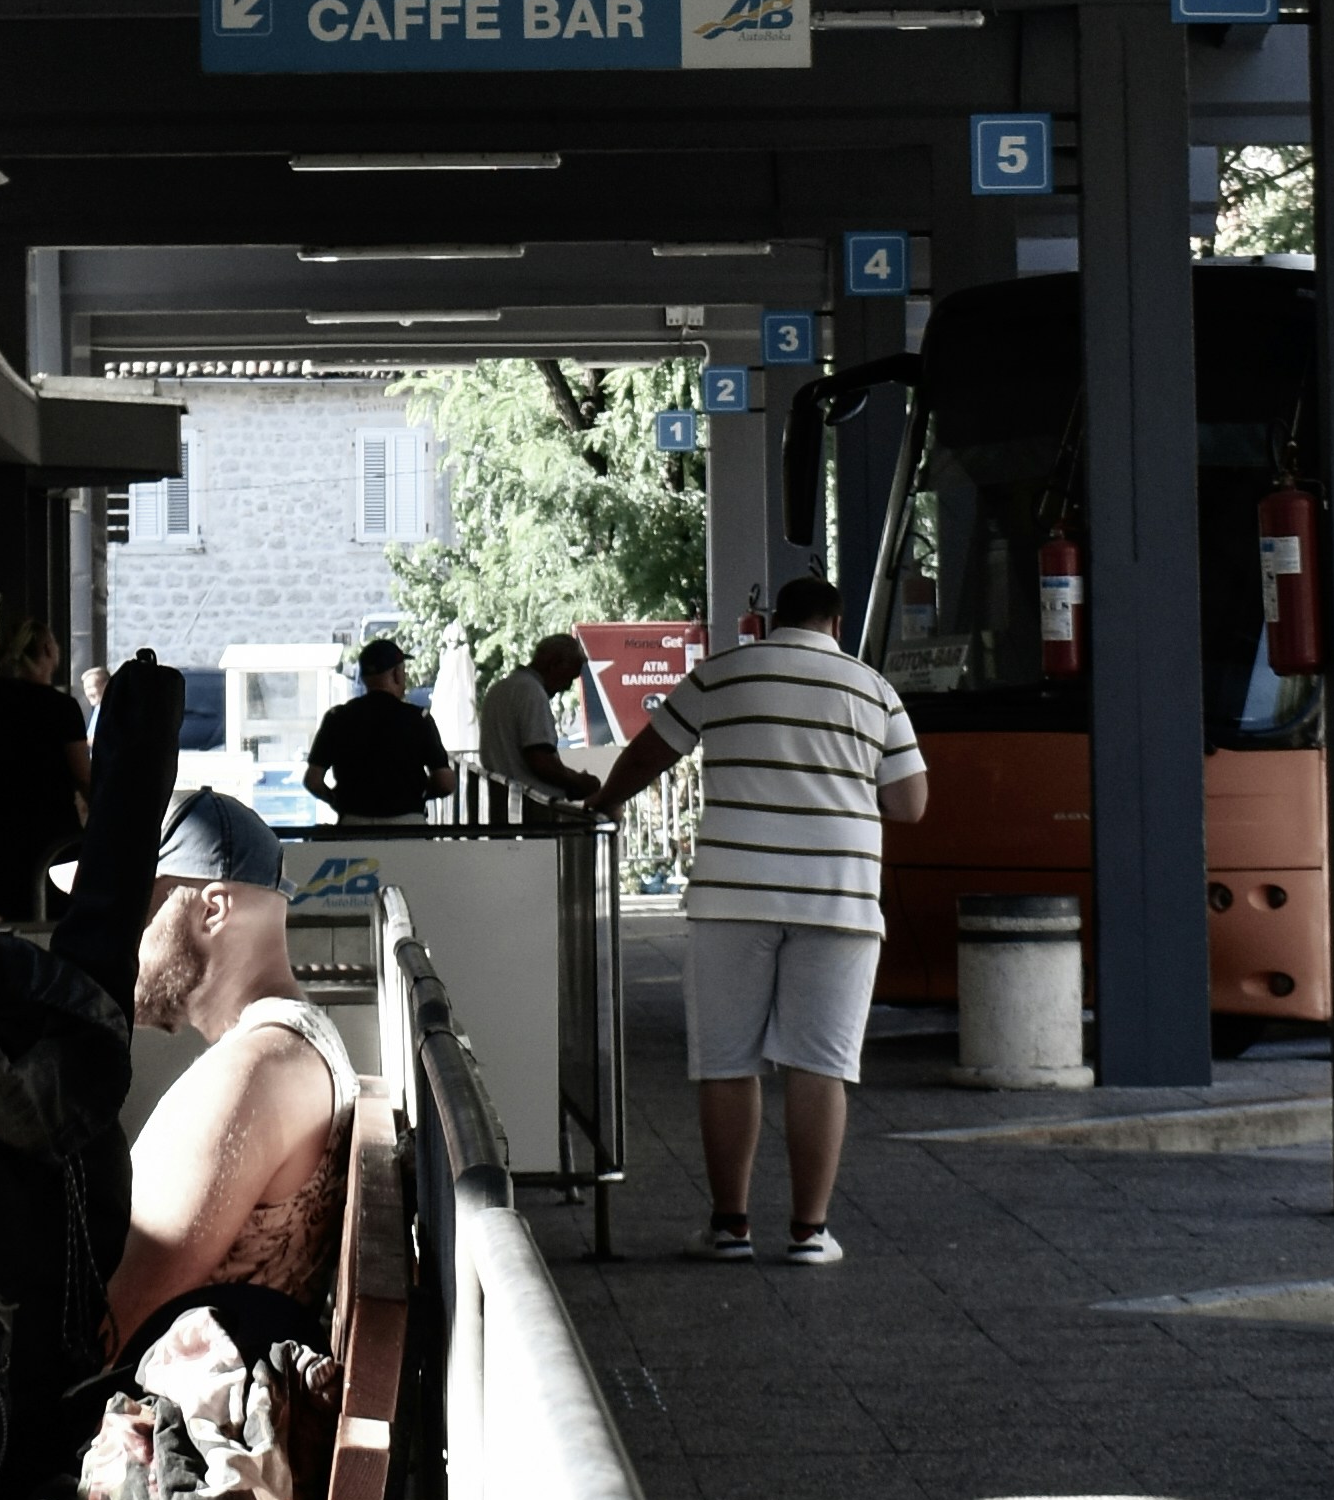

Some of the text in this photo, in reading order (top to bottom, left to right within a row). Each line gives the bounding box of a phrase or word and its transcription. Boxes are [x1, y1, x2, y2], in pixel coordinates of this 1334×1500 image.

[997, 135, 1029, 174] 5
[864, 248, 891, 280] 4
[778, 325, 799, 352] 3
[716, 378, 735, 402] 2
[669, 421, 683, 442] 1
[642, 660, 669, 673] ATM
[645, 699, 659, 710] 24
